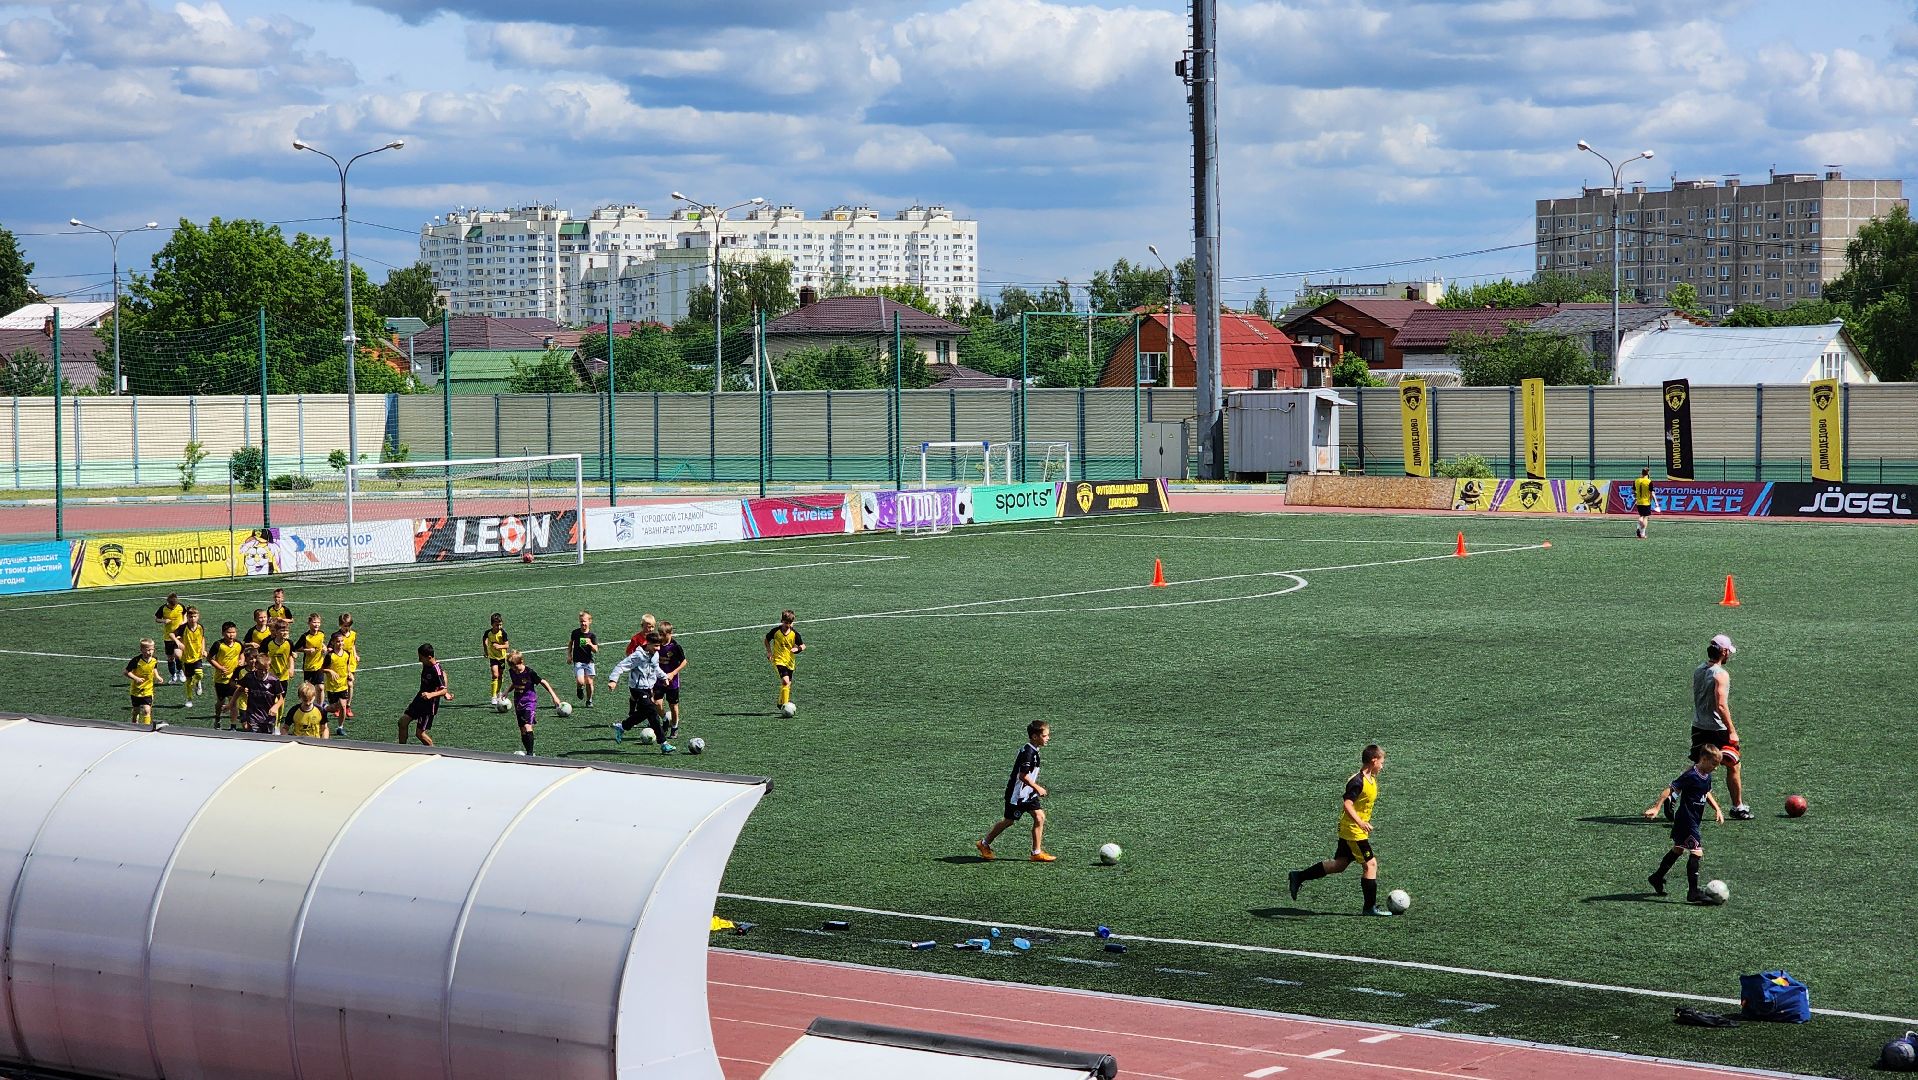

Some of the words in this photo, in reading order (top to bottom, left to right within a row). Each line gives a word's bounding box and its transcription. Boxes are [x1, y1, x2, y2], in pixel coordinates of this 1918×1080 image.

[1410, 418, 1422, 467] ДОМОДЕДОВО
[1672, 418, 1682, 469] DOMODEDOVO
[1818, 418, 1830, 470] ДОМОДЕДОВО
[134, 550, 152, 567] ФК
[154, 545, 228, 567] ДОМОДЕДОВО
[454, 513, 551, 554] LEON
